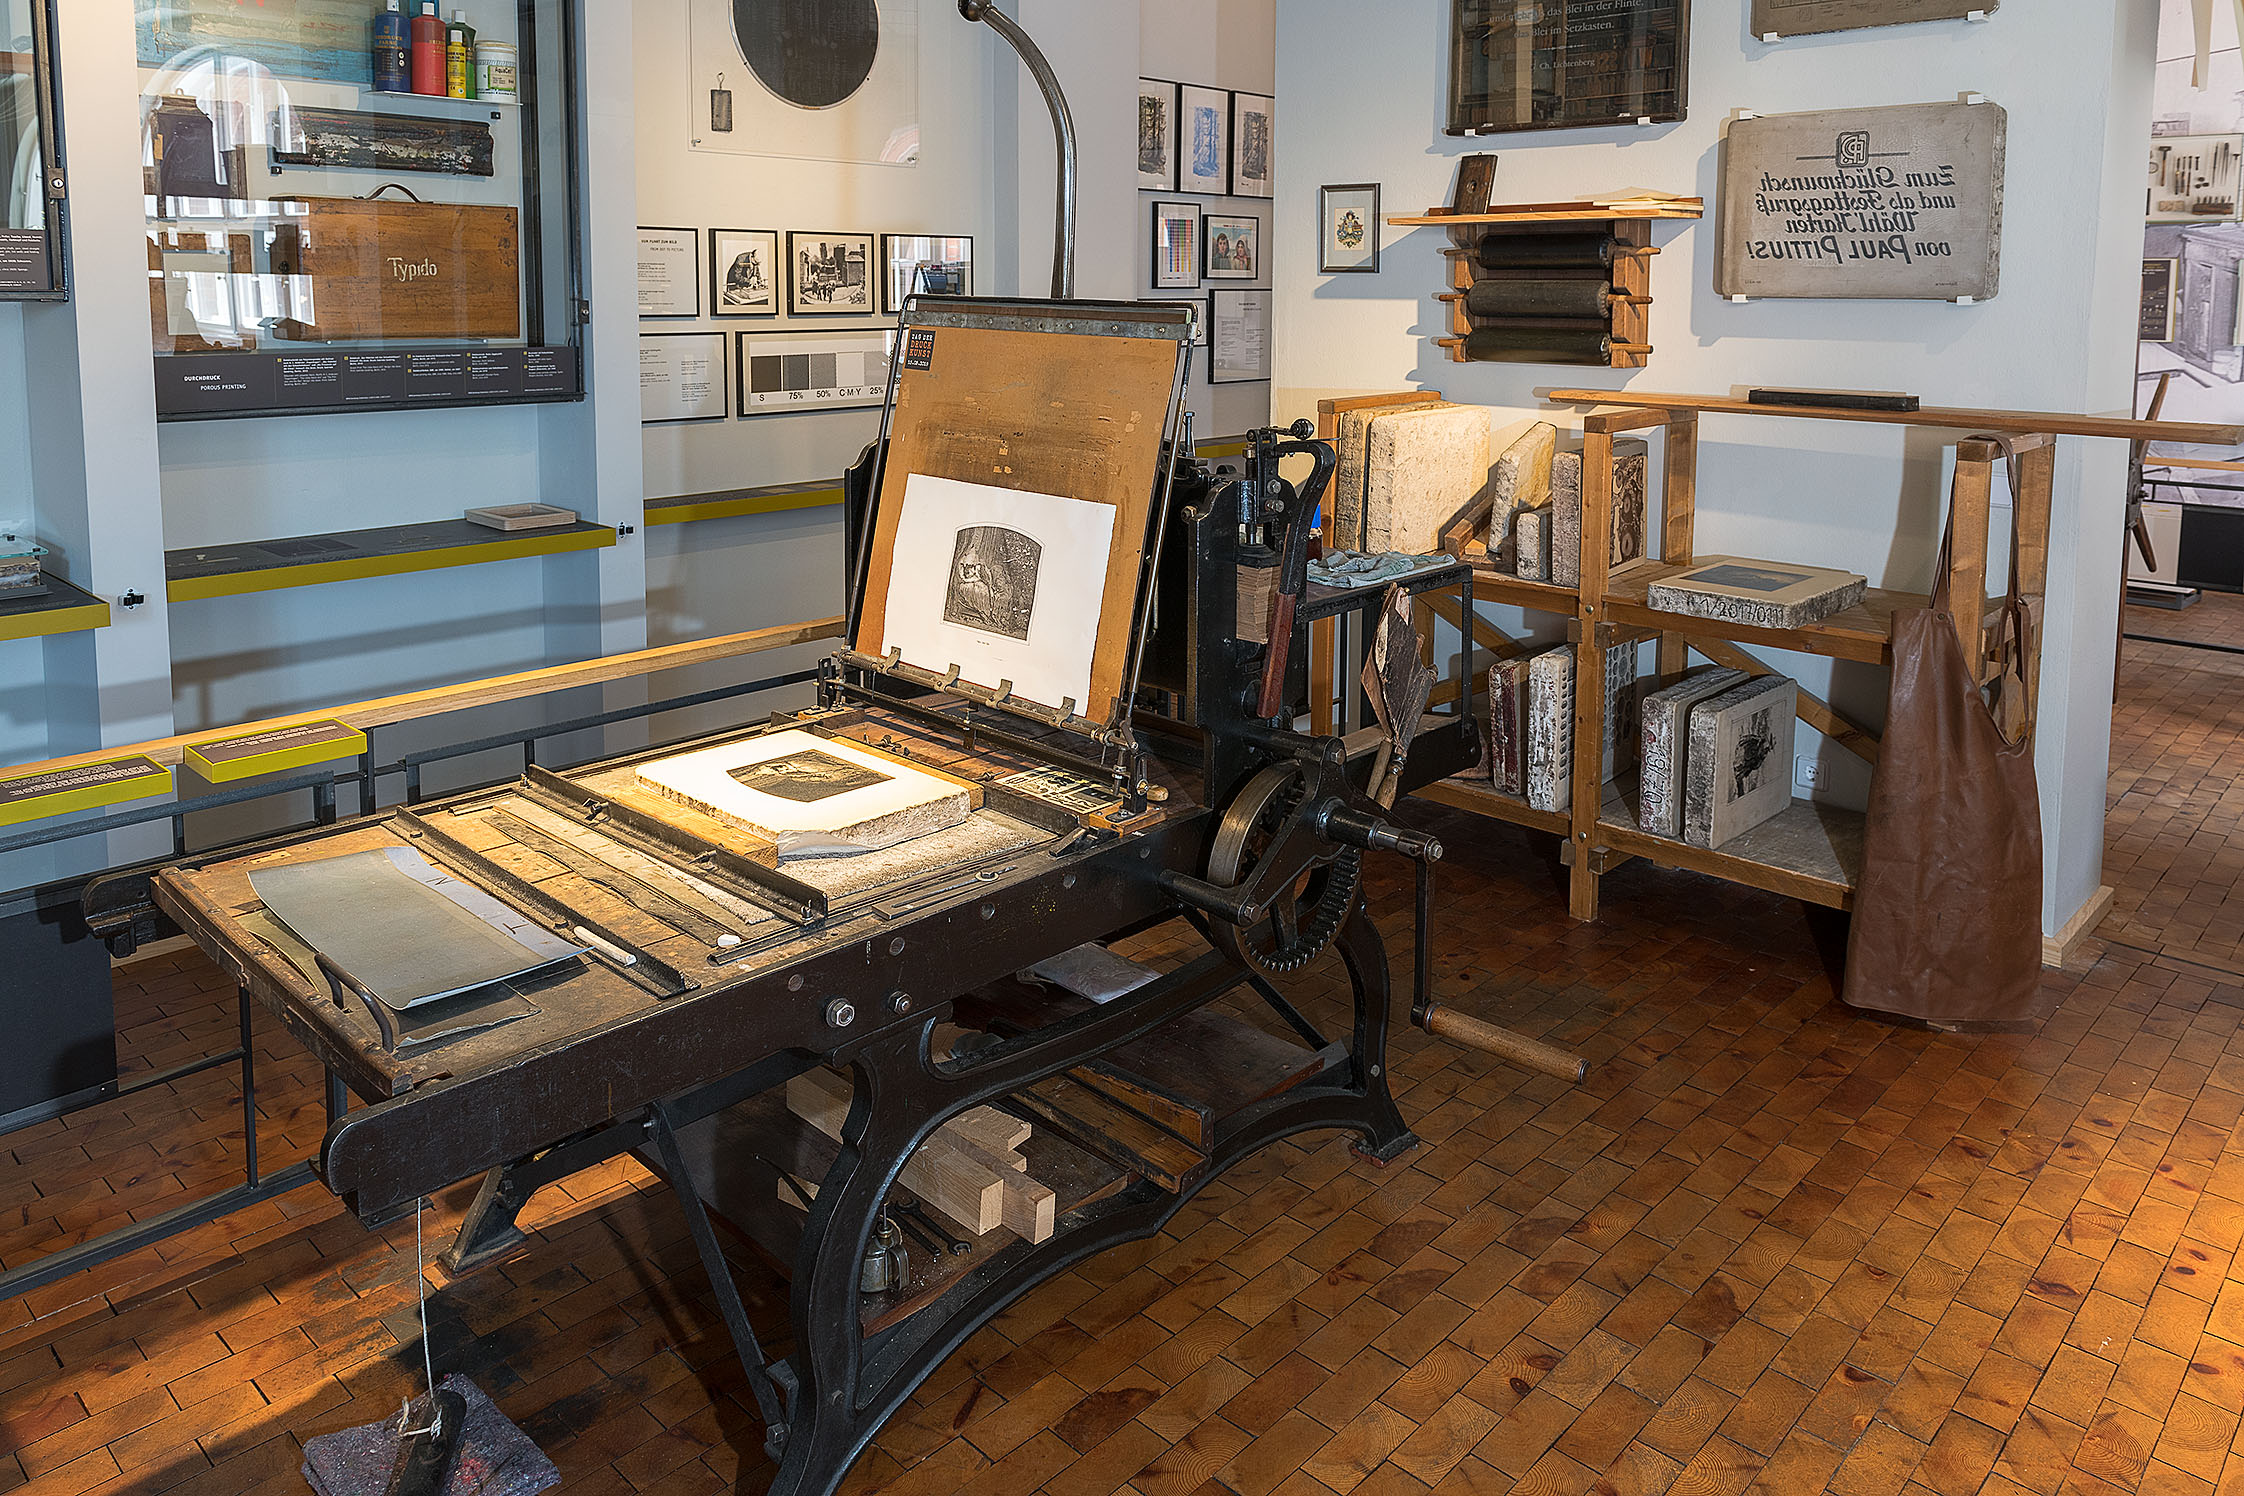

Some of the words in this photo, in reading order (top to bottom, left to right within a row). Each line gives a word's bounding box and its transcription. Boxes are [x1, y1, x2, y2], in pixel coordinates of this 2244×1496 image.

[1489, 14, 1506, 23] und
[1547, 6, 1563, 16] das
[1565, 4, 1584, 15] Blei
[1585, 4, 1594, 13] in
[1596, 1, 1613, 11] der
[1532, 26, 1549, 37] Blei
[1550, 25, 1562, 35] im
[1564, 20, 1615, 33] Setzkasten.
[1539, 61, 1553, 71] Ch.
[1554, 58, 1596, 70] Lichtenberg
[386, 257, 438, 282] Typido
[910, 340, 933, 350] DRUCK
[909, 348, 931, 358] KUNST
[788, 391, 804, 400] 75%
[816, 389, 831, 398] 50%
[869, 386, 884, 395] 25%
